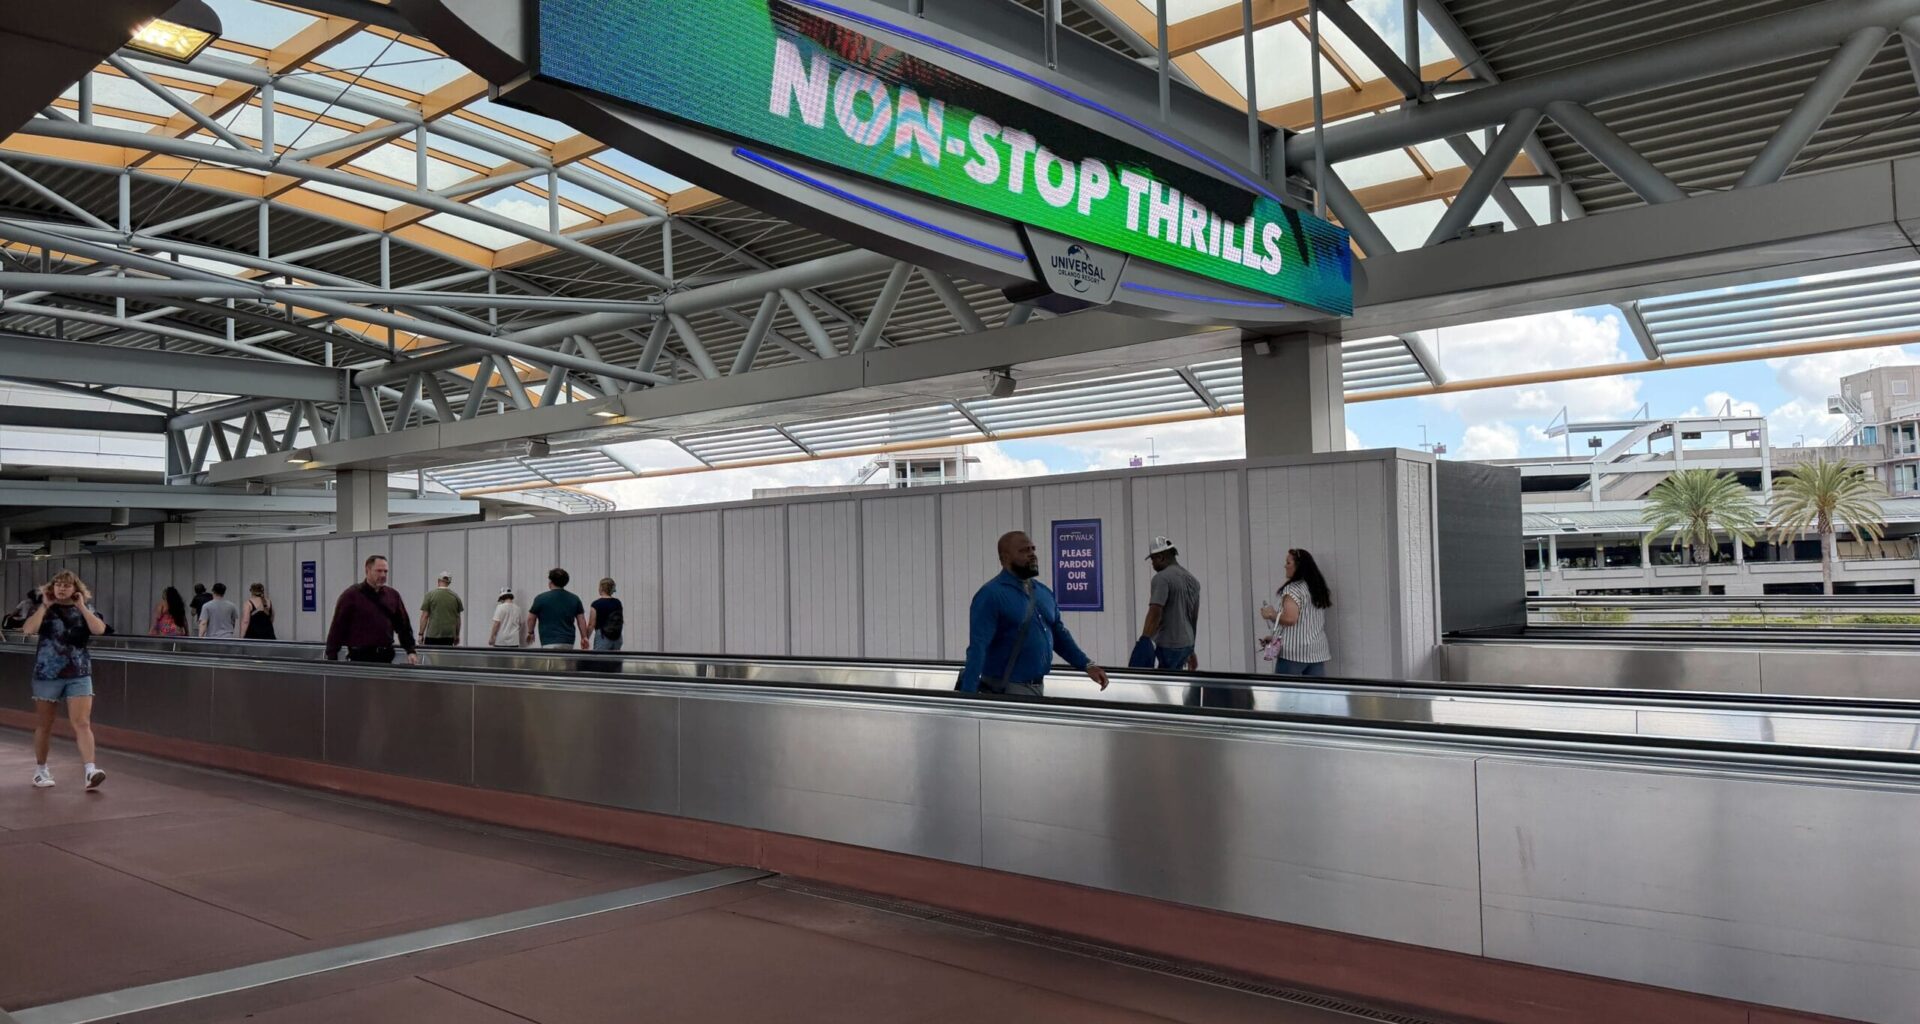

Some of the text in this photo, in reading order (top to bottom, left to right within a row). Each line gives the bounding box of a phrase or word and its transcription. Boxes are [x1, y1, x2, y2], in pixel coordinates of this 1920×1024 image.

[769, 38, 1282, 275] NON-STOP THRILLS
[1051, 256, 1106, 280] UNIVERSAL
[1058, 269, 1100, 284] ORLANDO RESORT
[1062, 549, 1092, 557] PLEASE
[1059, 560, 1094, 568] PARDON
[1068, 571, 1086, 579] OUR
